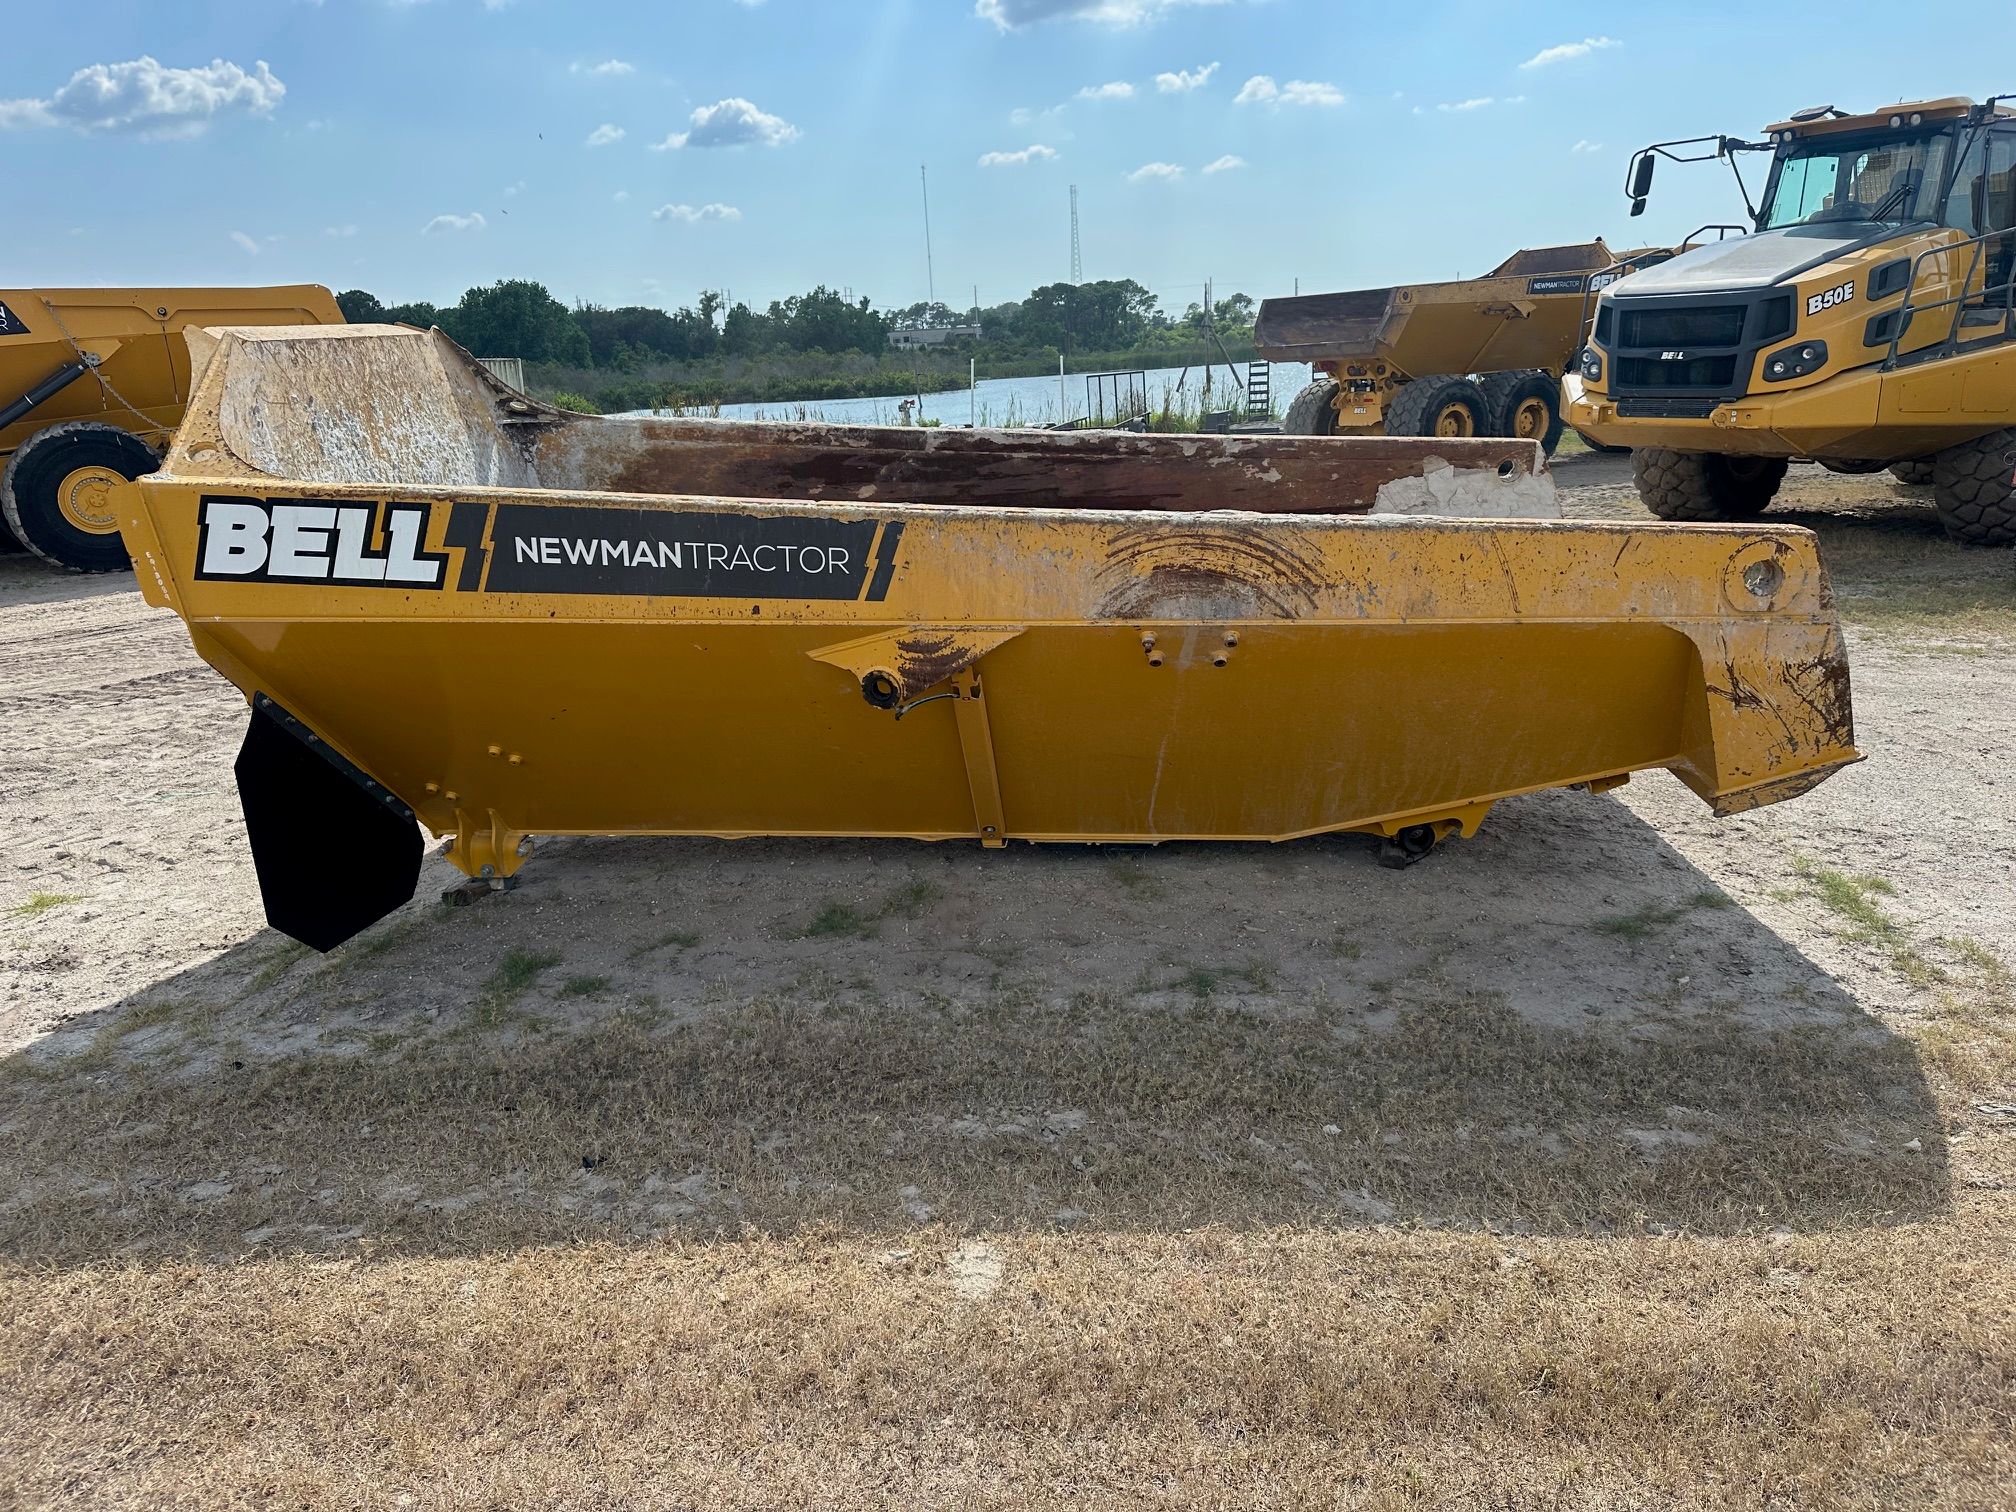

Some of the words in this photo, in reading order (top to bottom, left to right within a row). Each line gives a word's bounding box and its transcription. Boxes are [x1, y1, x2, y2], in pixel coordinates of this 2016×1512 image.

[1807, 281, 1854, 316] B50E
[1660, 351, 1684, 360] BELL
[202, 502, 441, 583] BELL
[513, 536, 850, 575] NEWMANTRACTOR
